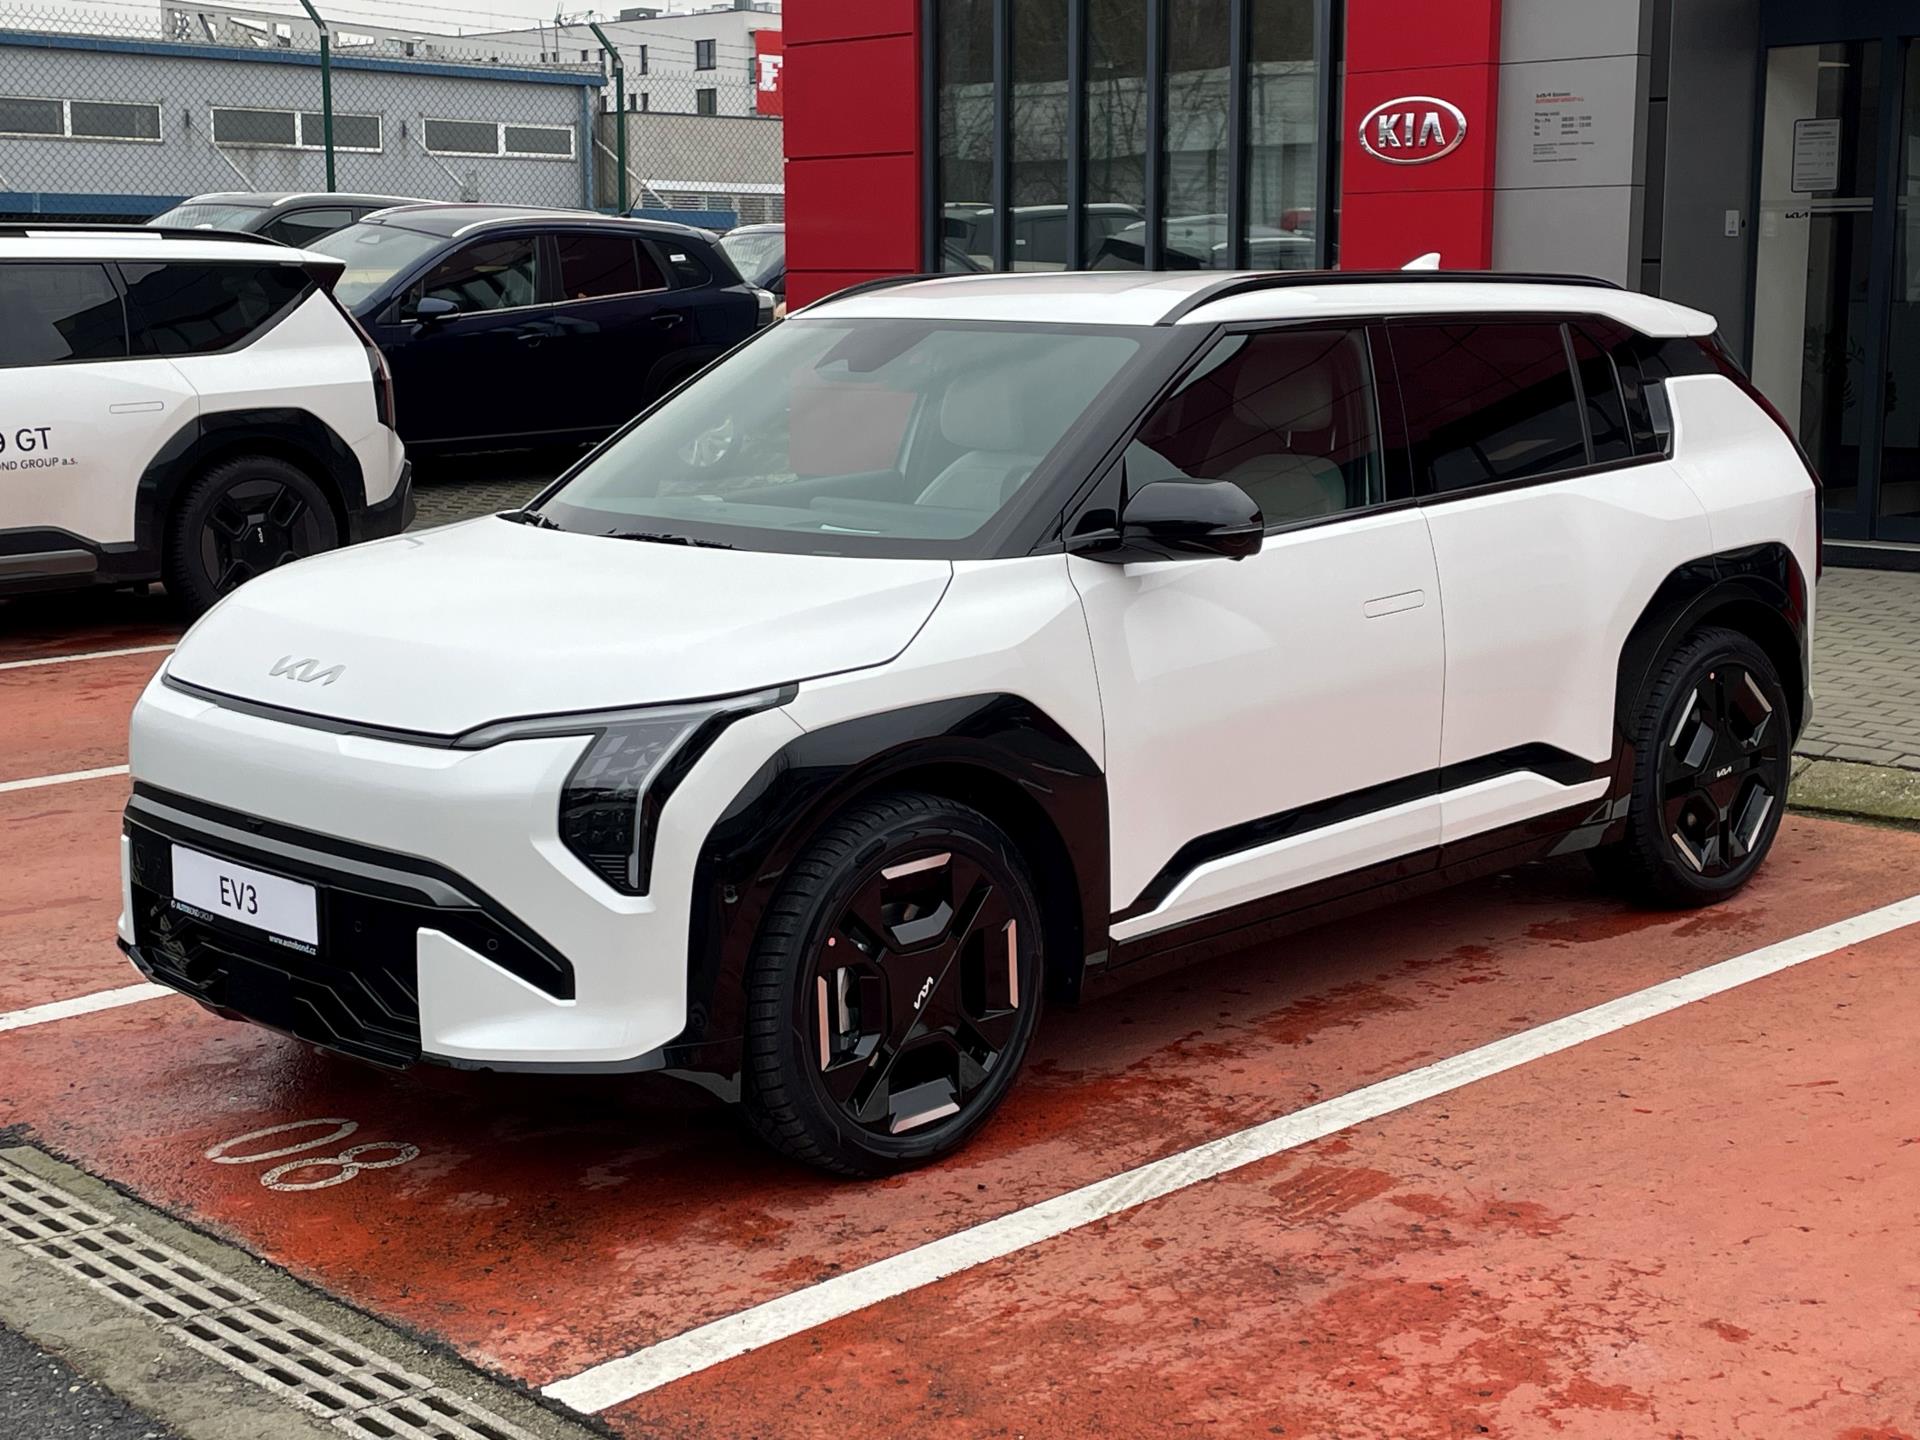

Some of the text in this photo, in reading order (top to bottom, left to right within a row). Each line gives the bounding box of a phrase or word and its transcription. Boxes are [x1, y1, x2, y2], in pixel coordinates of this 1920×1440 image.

[1378, 112, 1446, 148] KIA
[15, 427, 52, 452] GT
[20, 456, 59, 470] GROUP
[61, 458, 79, 466] a.s.
[268, 654, 346, 687] KIA
[219, 875, 259, 915] EV3
[204, 1117, 421, 1192] 08
